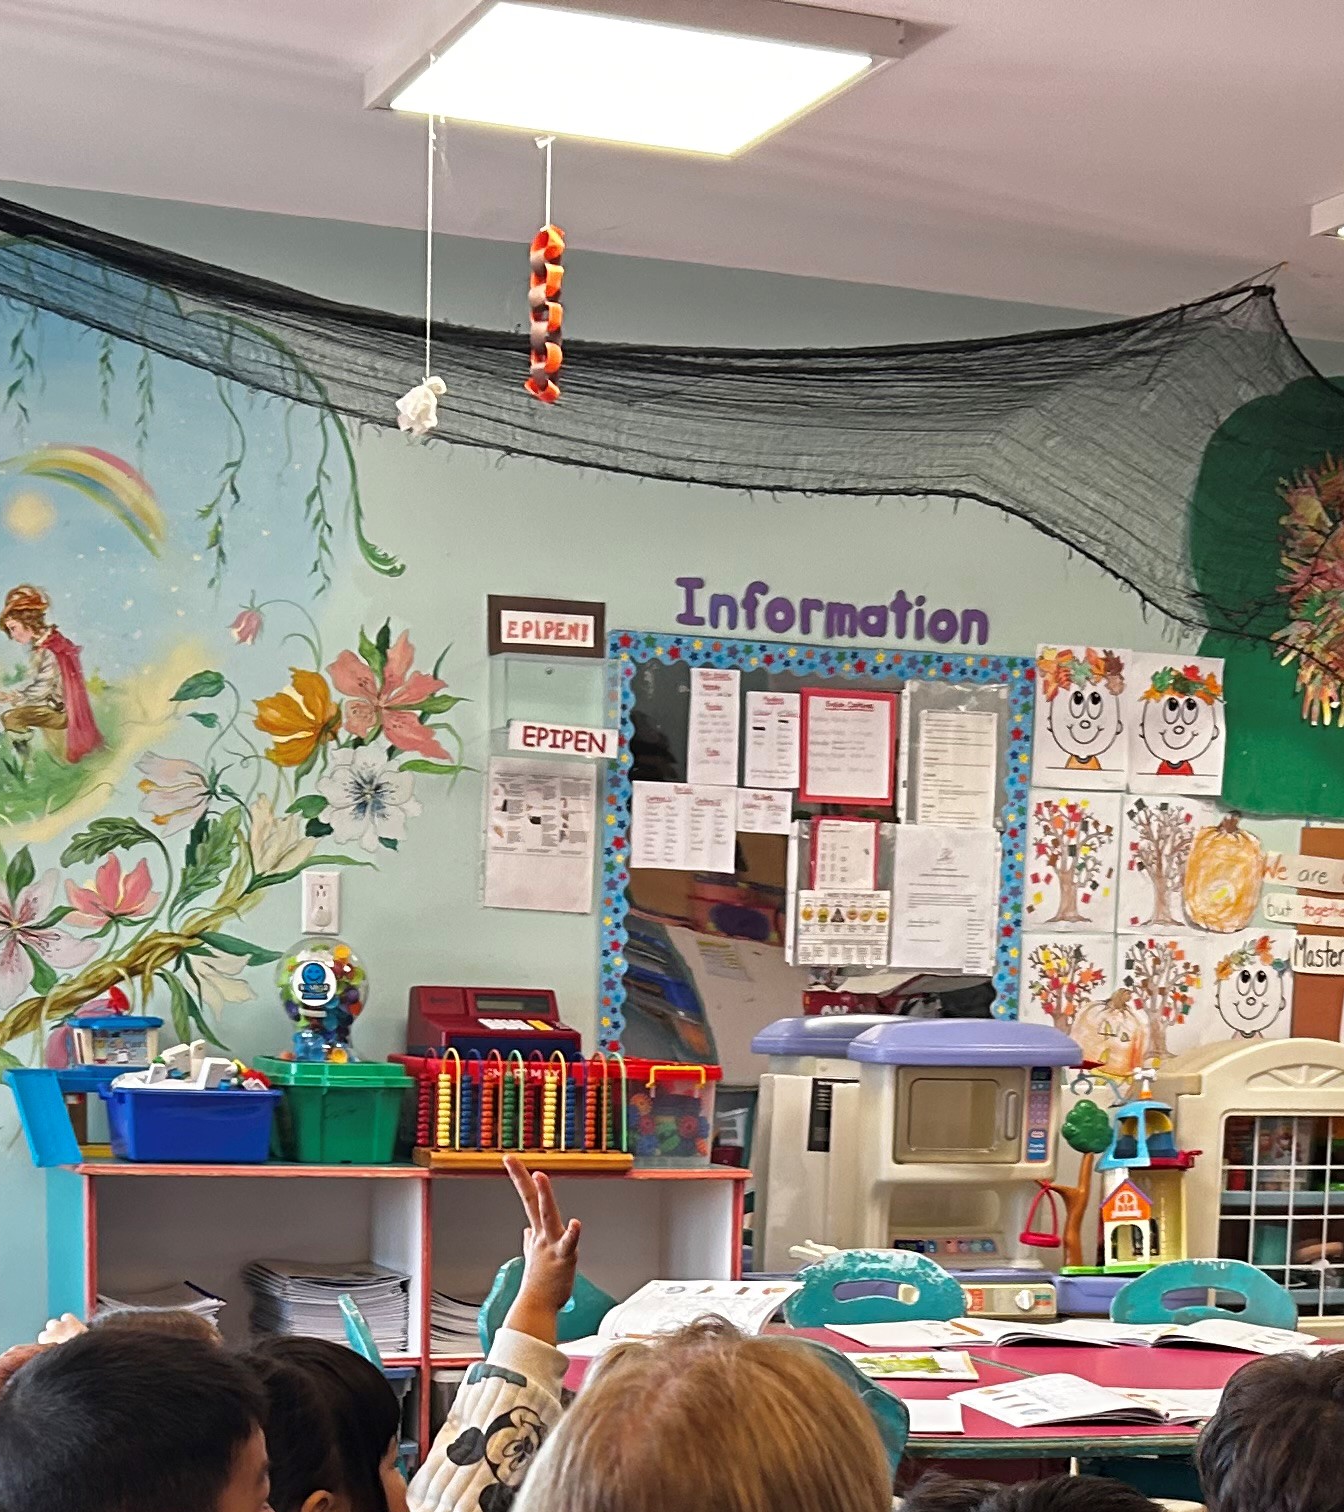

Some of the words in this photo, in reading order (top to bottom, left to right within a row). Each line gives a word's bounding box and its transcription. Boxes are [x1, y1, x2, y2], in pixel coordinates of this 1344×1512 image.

[674, 576, 989, 646] Information
[506, 620, 589, 643] EPIPEN!
[522, 725, 606, 754] EPIPEN
[1262, 854, 1288, 881] We
[1298, 869, 1328, 885] are
[1266, 900, 1292, 918] but
